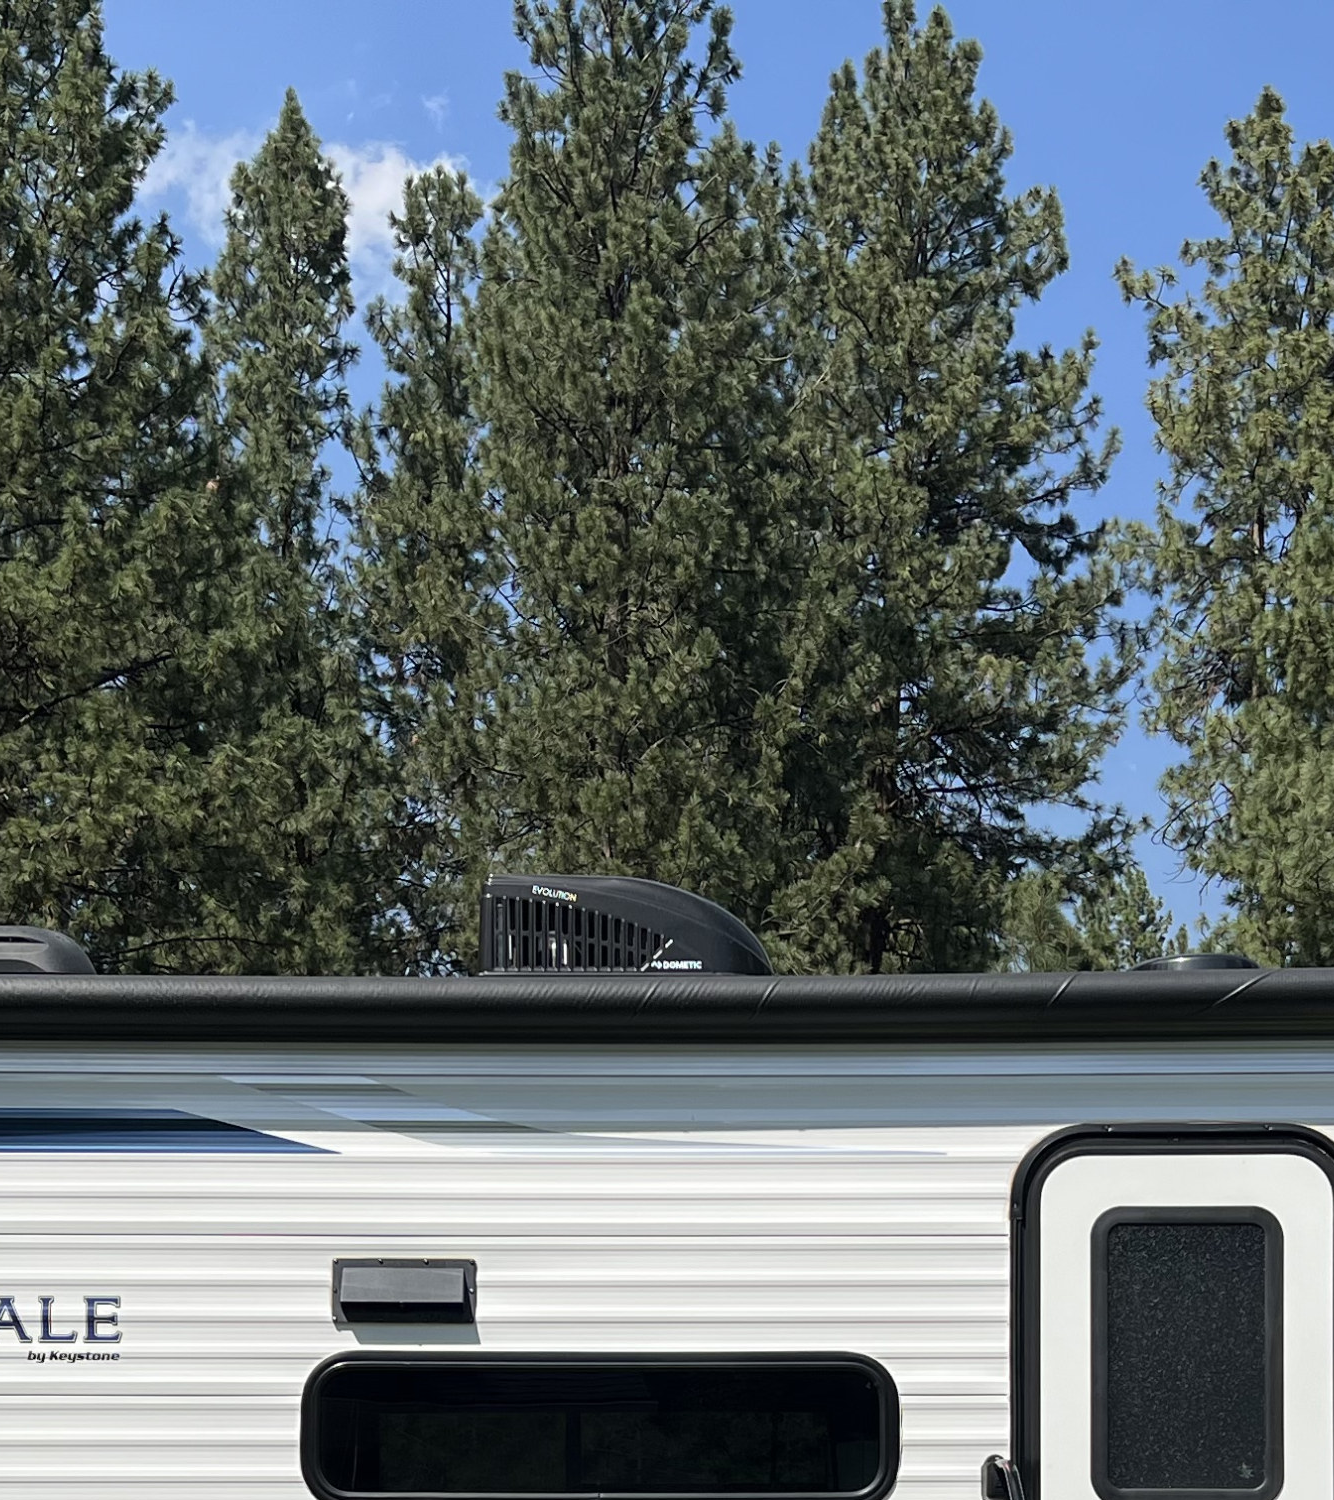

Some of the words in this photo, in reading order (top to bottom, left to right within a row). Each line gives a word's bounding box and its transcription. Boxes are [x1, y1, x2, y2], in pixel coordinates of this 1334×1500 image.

[532, 885, 577, 902] EVOLUTION
[663, 960, 702, 970] DOMETIC
[27, 1350, 46, 1364] by
[49, 1350, 120, 1364] Keystone
